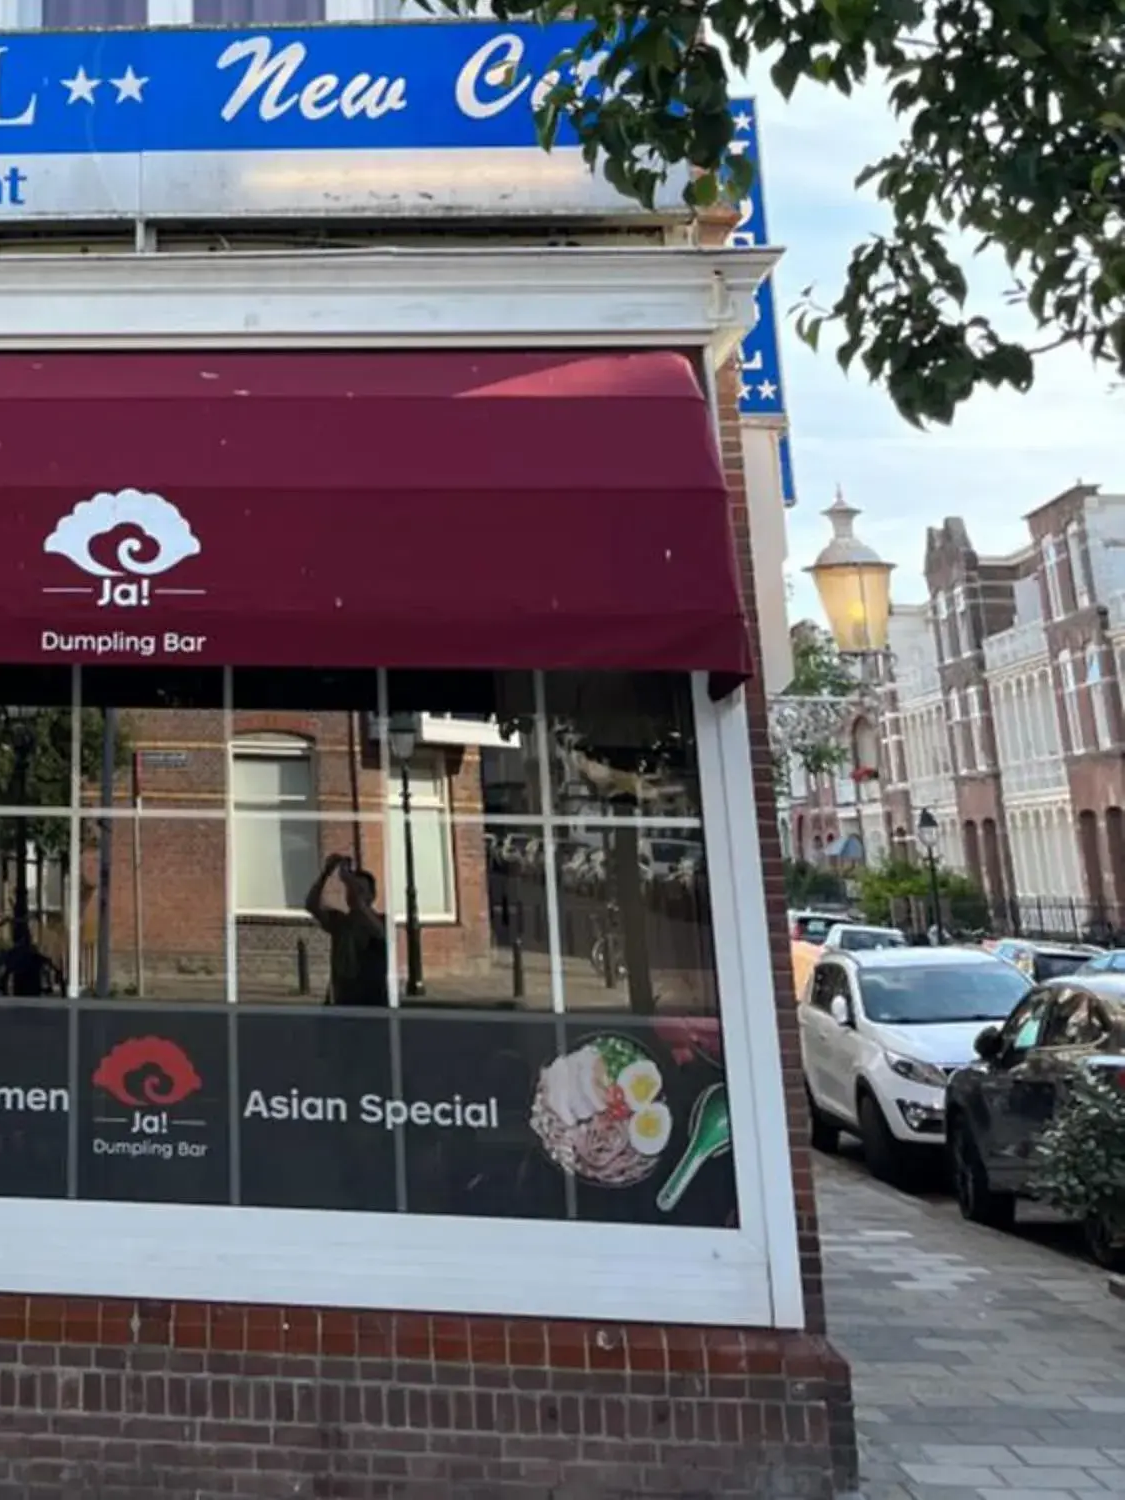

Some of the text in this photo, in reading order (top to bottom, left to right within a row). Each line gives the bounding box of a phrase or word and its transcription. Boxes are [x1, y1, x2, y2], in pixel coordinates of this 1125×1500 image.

[216, 35, 408, 123] New
[455, 32, 645, 122] Cit
[96, 578, 151, 607] Ja!
[41, 631, 207, 656] Dumpling Bar
[130, 1110, 168, 1134] Ja!
[243, 1087, 499, 1130] Asian Special
[92, 1138, 209, 1159] Dumpling Bar
